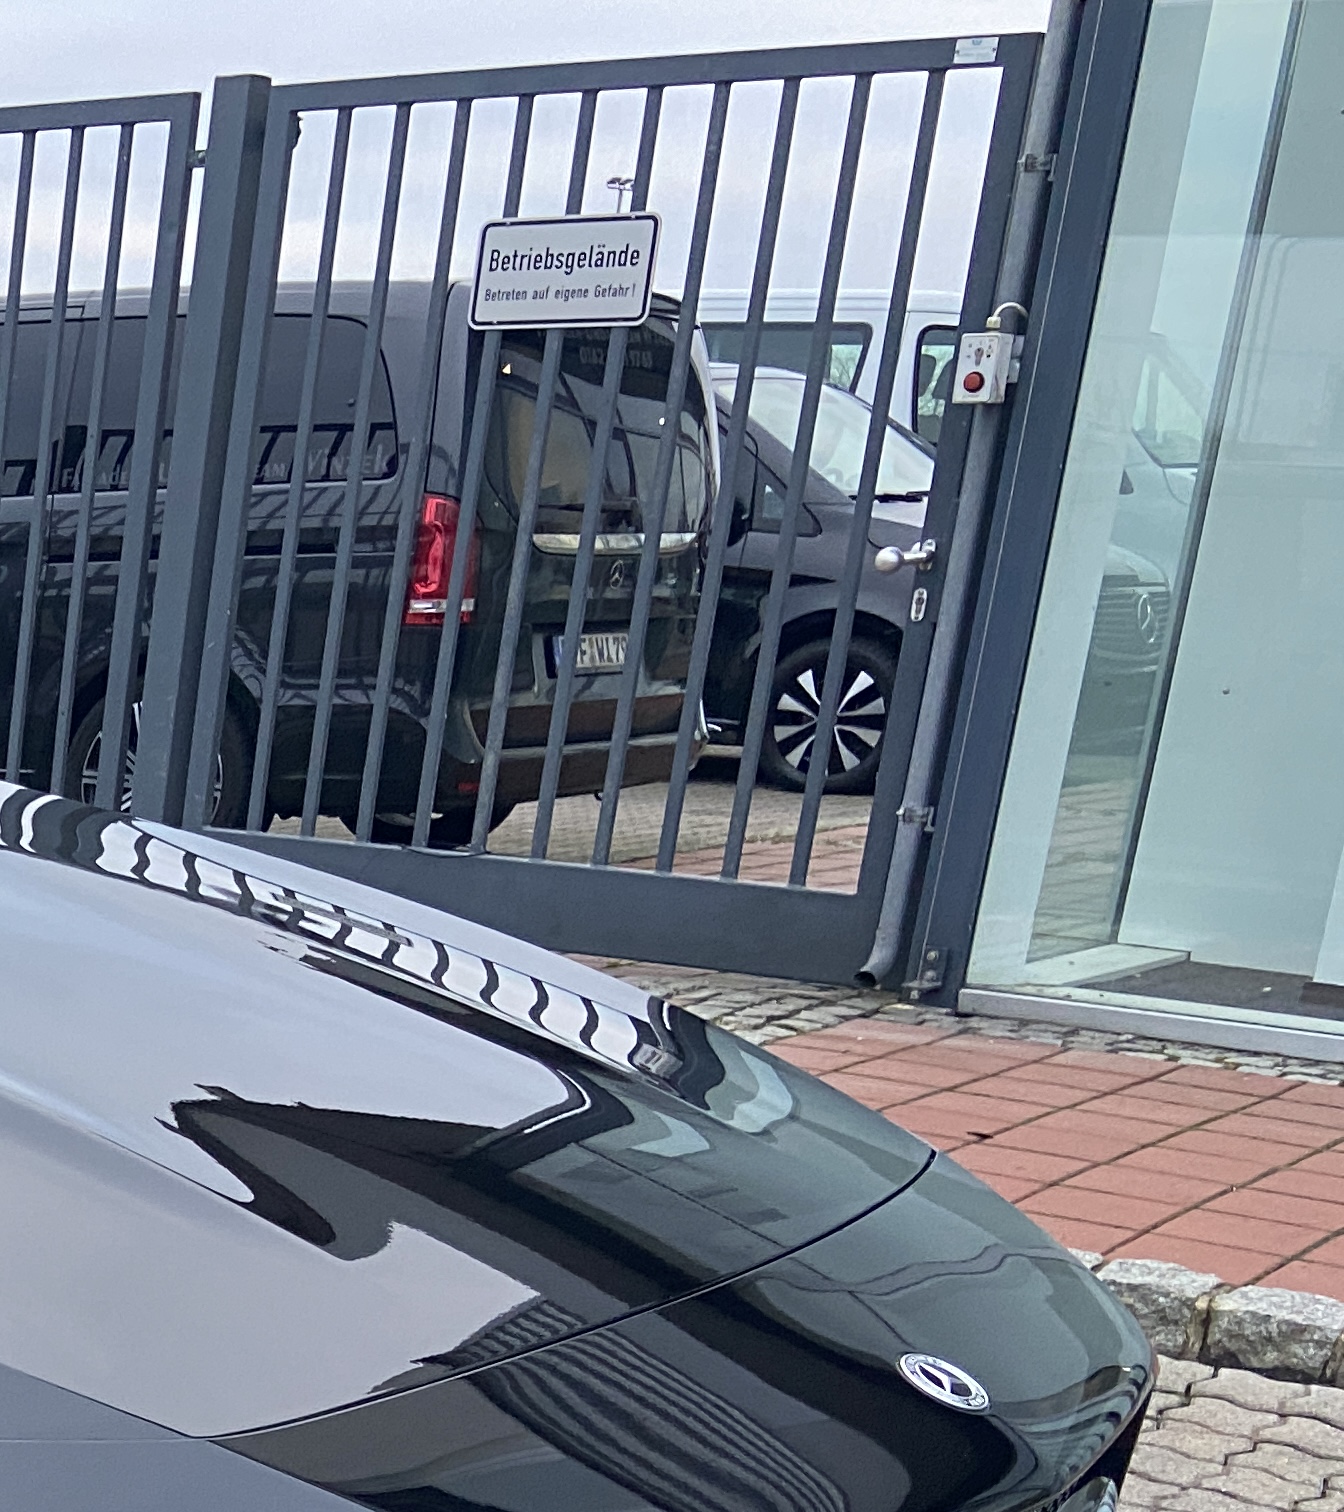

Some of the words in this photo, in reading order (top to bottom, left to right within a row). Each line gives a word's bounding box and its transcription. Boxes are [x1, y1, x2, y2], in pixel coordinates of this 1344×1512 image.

[488, 243, 640, 276] Betriebsgelände
[484, 287, 528, 302] Betreten
[532, 286, 550, 300] auf
[554, 285, 589, 303] eigene
